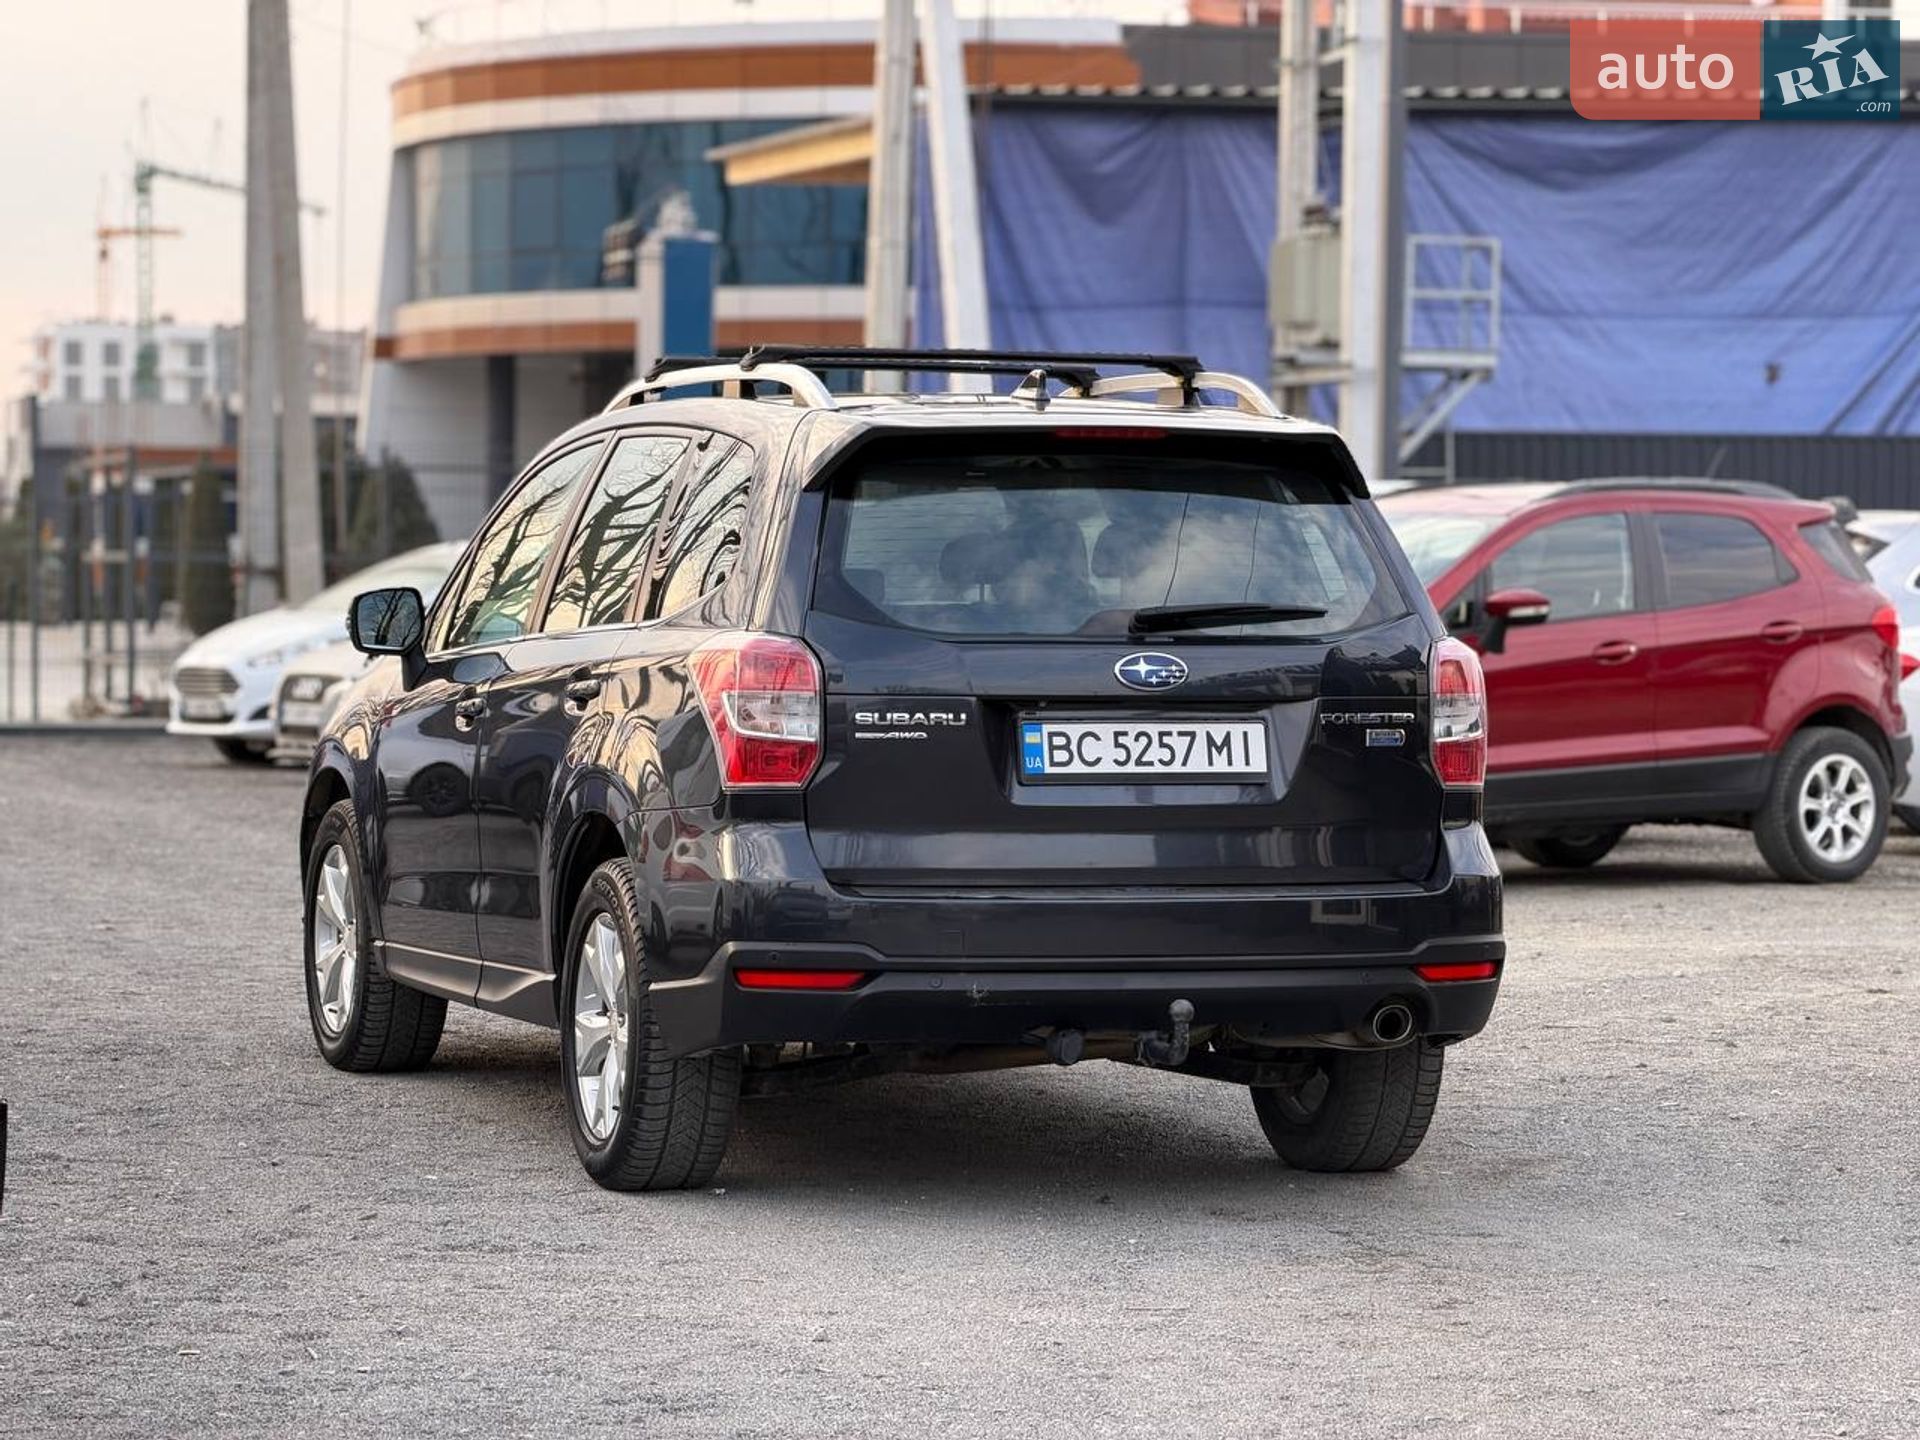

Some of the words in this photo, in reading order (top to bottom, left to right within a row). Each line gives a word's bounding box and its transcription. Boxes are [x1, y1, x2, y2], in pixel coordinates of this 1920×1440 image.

[855, 712, 966, 726] SUBARU
[1320, 712, 1415, 724] FORESTER
[1047, 731, 1103, 768] BC
[1112, 730, 1197, 768] 5257
[1206, 730, 1251, 767] MI
[1025, 758, 1043, 768] UA
